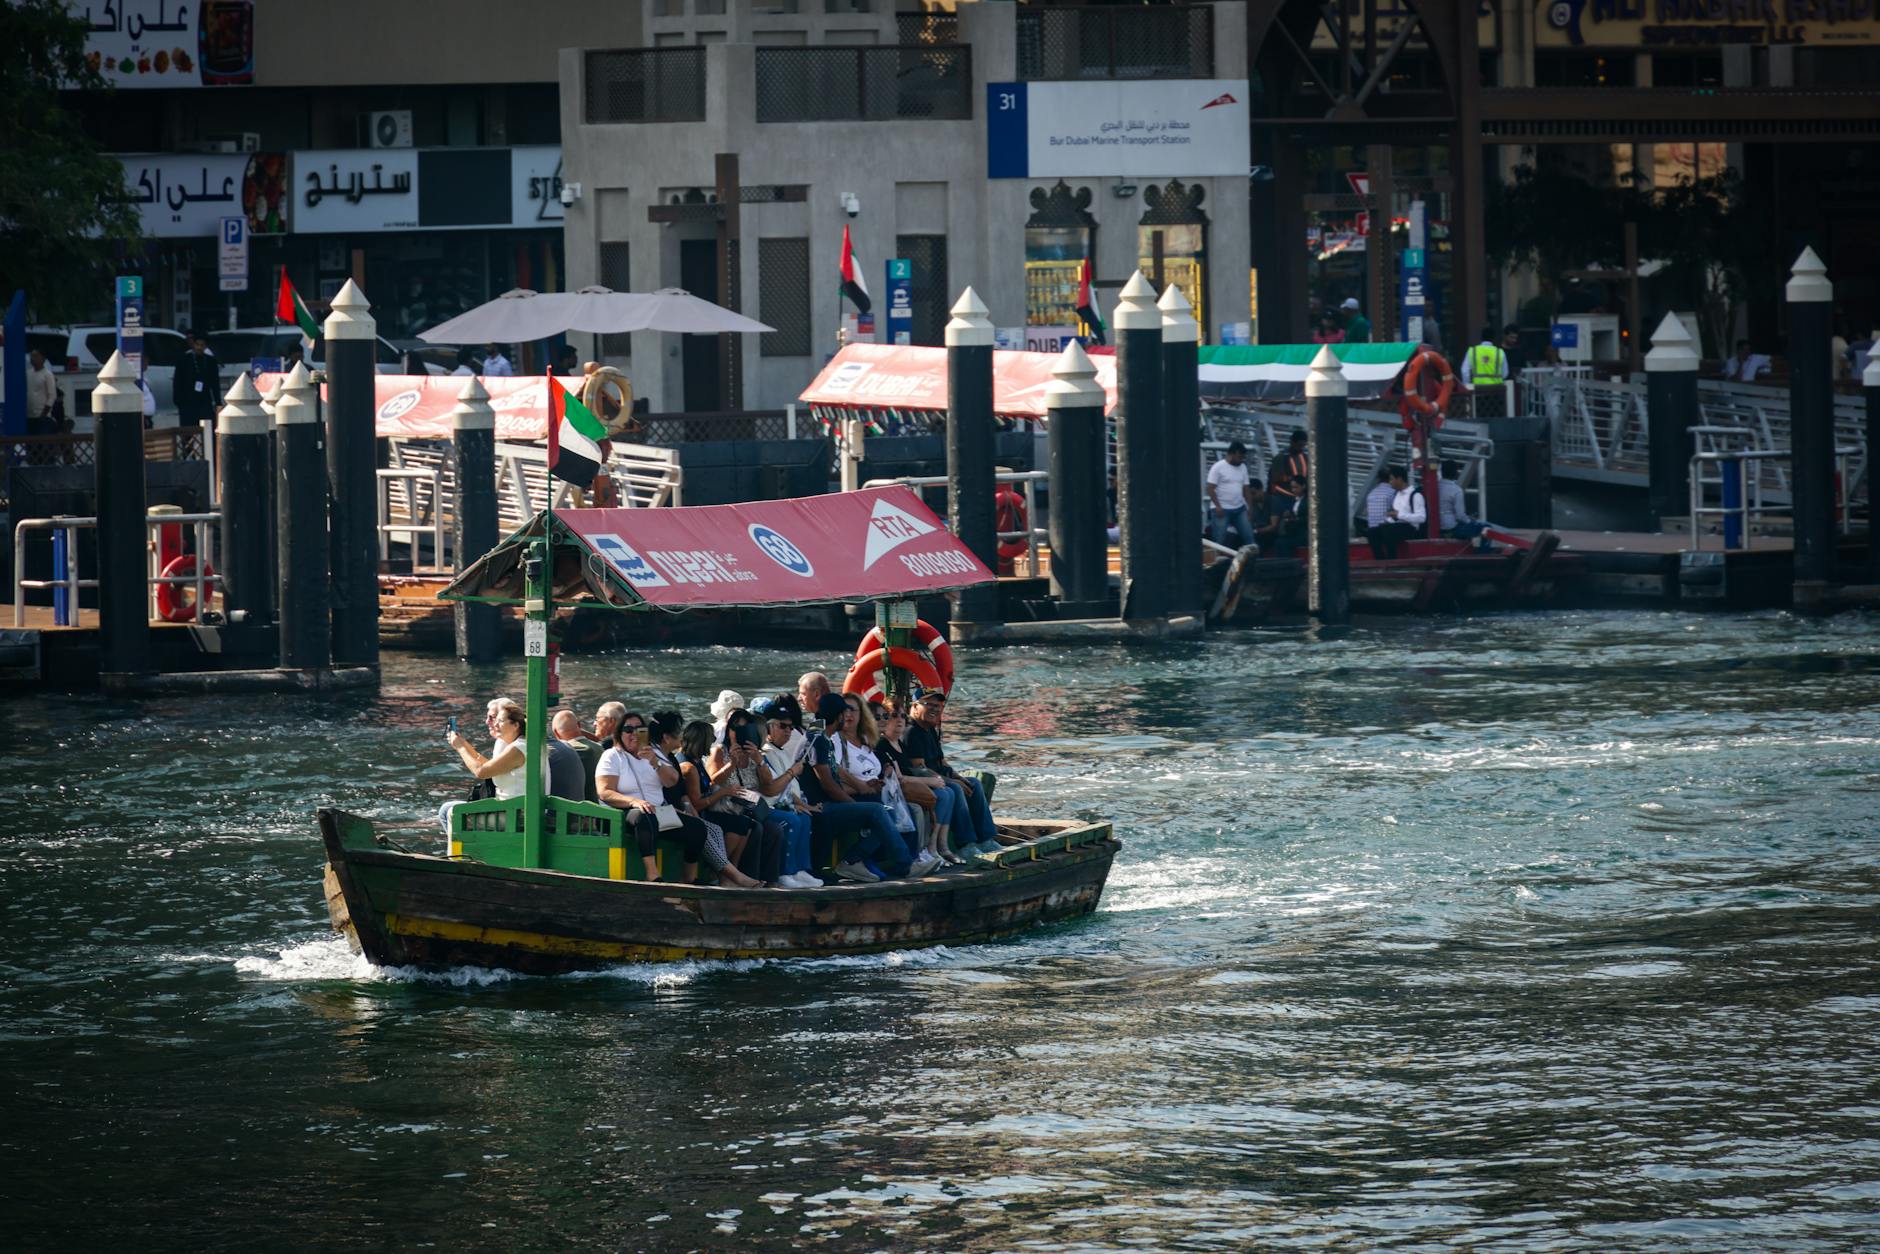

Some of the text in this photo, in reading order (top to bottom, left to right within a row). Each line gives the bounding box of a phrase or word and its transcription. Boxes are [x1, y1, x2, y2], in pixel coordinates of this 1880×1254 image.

[999, 93, 1016, 110] 31
[1099, 119, 1124, 133] البحري
[1125, 119, 1145, 132] للنقل
[1145, 121, 1159, 132] دبي
[1168, 120, 1190, 129] محطة
[1049, 134, 1190, 147] Bur Dubai Marine Transport Station
[166, 167, 235, 222] علي
[227, 221, 240, 243] P
[1411, 251, 1418, 265] 1
[896, 262, 905, 276] 2
[127, 279, 137, 294] 3
[870, 514, 923, 539] RTA
[757, 534, 804, 566] 68
[899, 549, 978, 578] 8009090
[529, 641, 541, 654] 68
